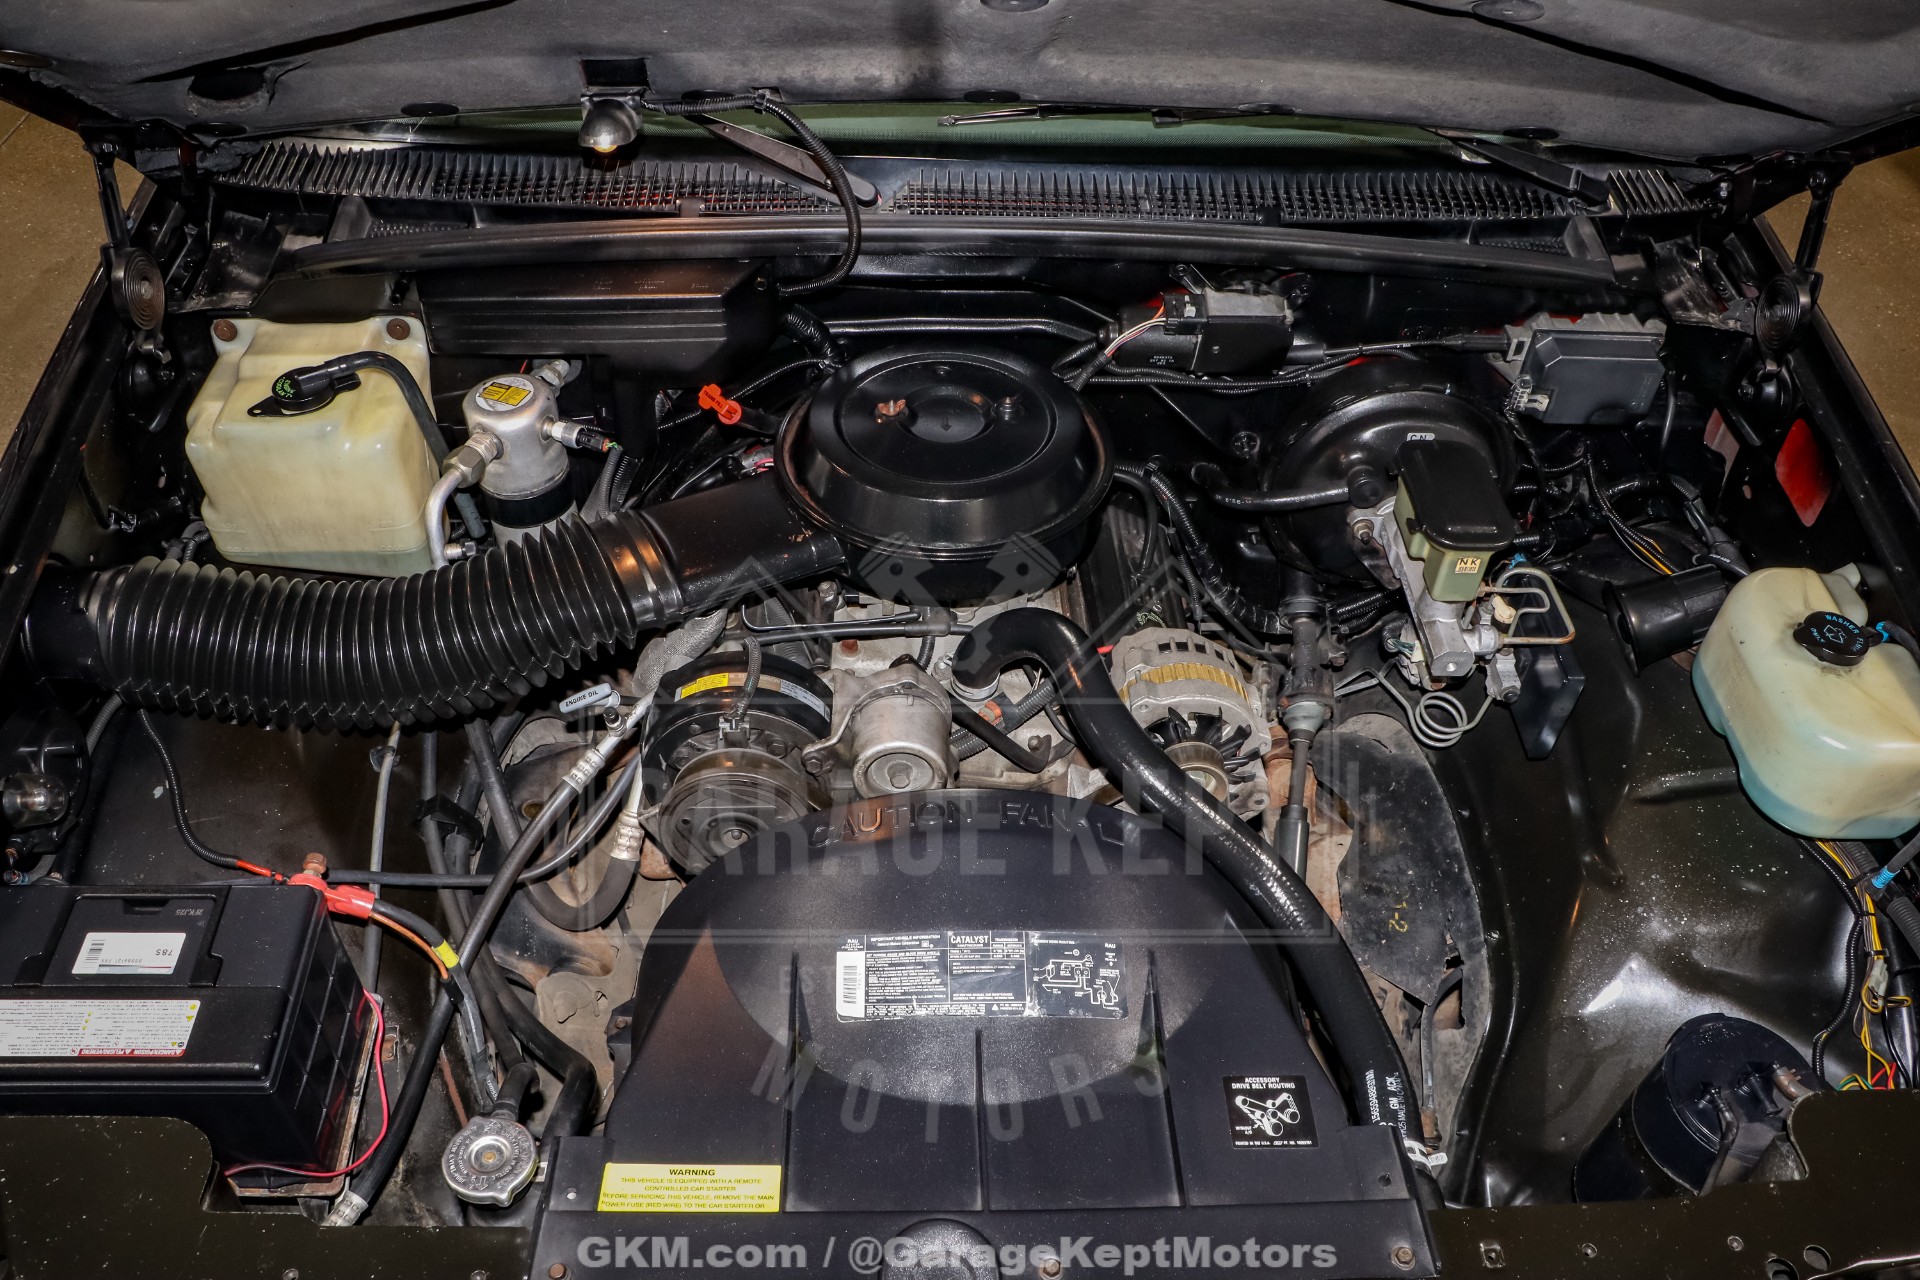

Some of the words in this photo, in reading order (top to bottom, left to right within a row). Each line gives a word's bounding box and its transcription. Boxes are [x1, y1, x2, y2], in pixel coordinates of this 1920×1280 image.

[1824, 614, 1860, 634] WASHER
[1810, 627, 1826, 643] ONLY
[565, 694, 587, 707] ENGINE
[588, 690, 599, 698] OIL
[807, 799, 973, 847] CAUTION
[950, 935, 989, 944] CATALYST
[155, 948, 174, 956] 78S
